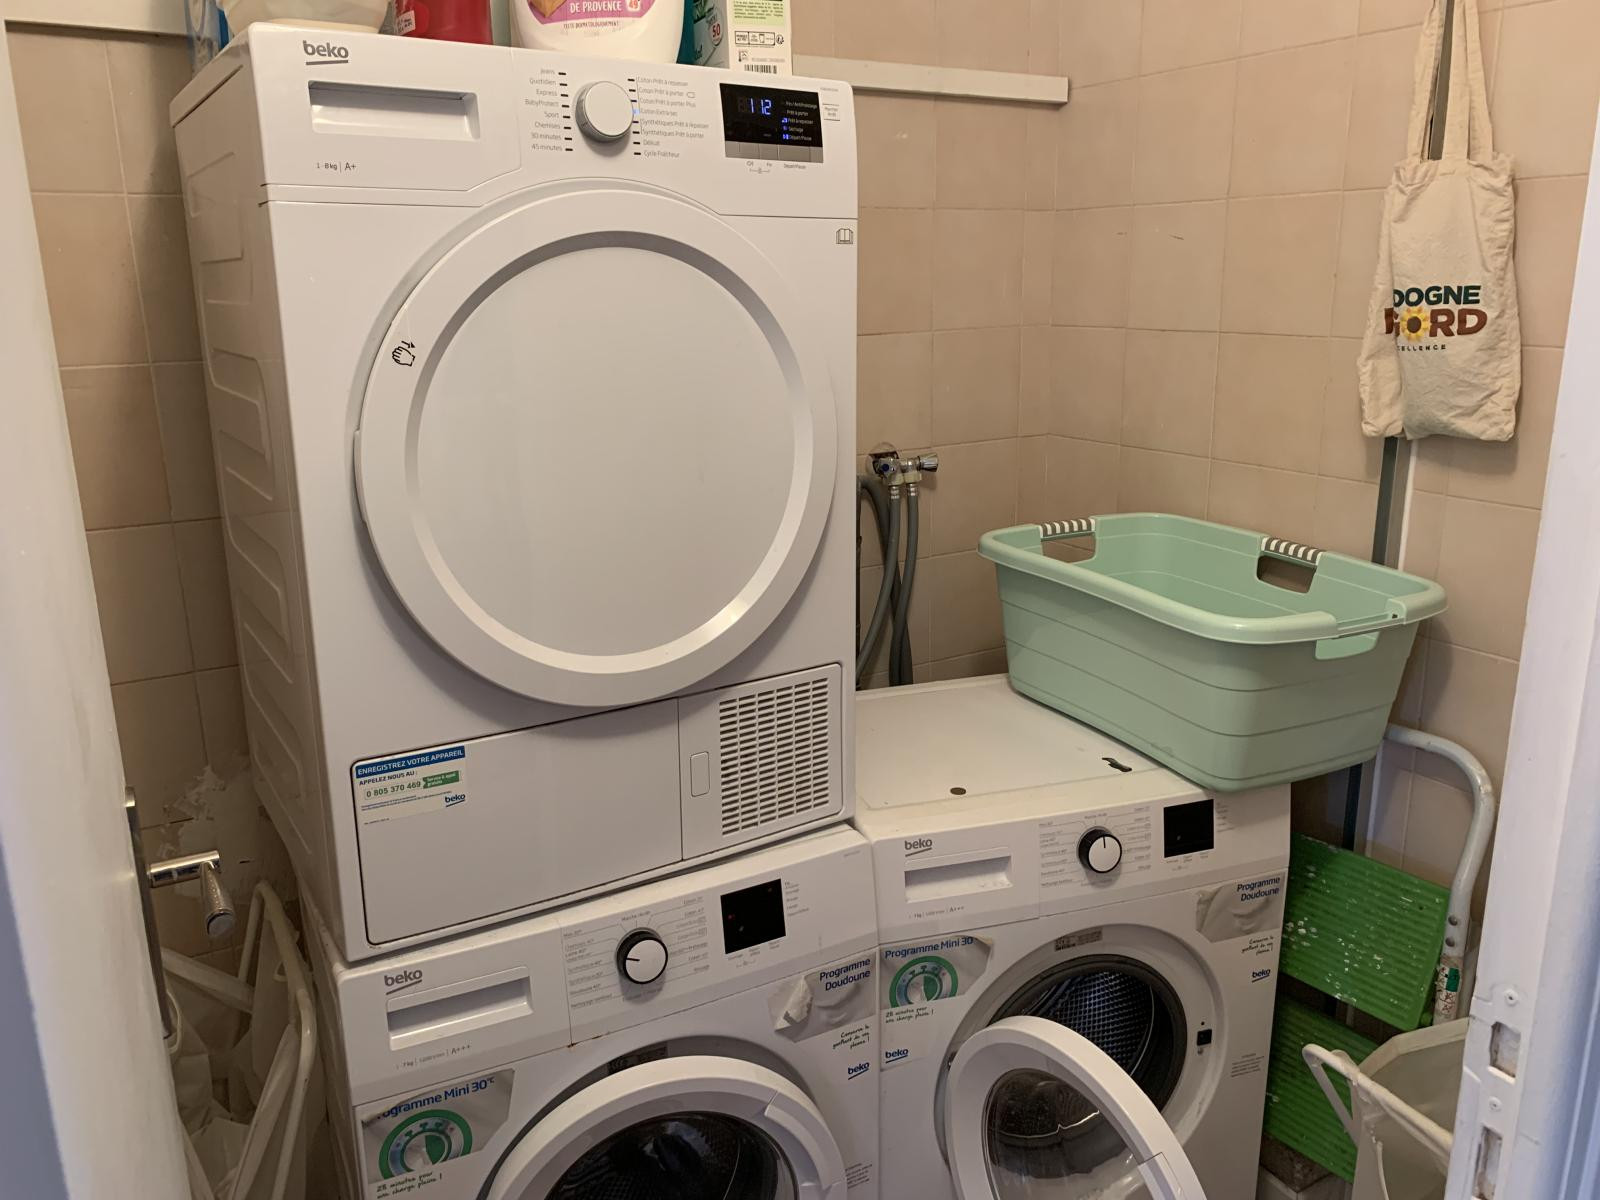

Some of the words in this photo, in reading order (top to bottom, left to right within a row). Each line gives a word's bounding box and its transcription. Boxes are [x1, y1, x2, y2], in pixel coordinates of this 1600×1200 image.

[570, 3, 582, 14] DE
[583, 1, 622, 13] PROVENCE
[712, 23, 721, 38] 50
[302, 40, 349, 59] beko
[344, 162, 357, 171] A+
[357, 760, 406, 775] ENREGISTREZ
[407, 755, 430, 767] VOTRE
[431, 749, 464, 761] APPAREIL
[359, 775, 387, 786] APPELEZ
[388, 772, 405, 781] NOUS
[366, 790, 372, 798] 0
[373, 787, 389, 797] 805
[390, 784, 405, 793] 370
[444, 793, 466, 804] beko
[904, 838, 933, 851] beko
[1236, 876, 1280, 893] Programme
[1241, 886, 1280, 902] Doudoune
[884, 942, 940, 959] Programme
[941, 940, 960, 949] Mini
[819, 958, 871, 981] Programme
[1252, 968, 1271, 979] beko
[384, 969, 423, 987] beko
[825, 969, 871, 991] Doudoune
[895, 1007, 914, 1016] minutes
[885, 1047, 909, 1059] beko
[847, 1061, 870, 1075] beko
[444, 1083, 470, 1101] Mini
[390, 1176, 416, 1189] minutes
[391, 1184, 416, 1197] charge
[417, 1177, 437, 1189] pleine
